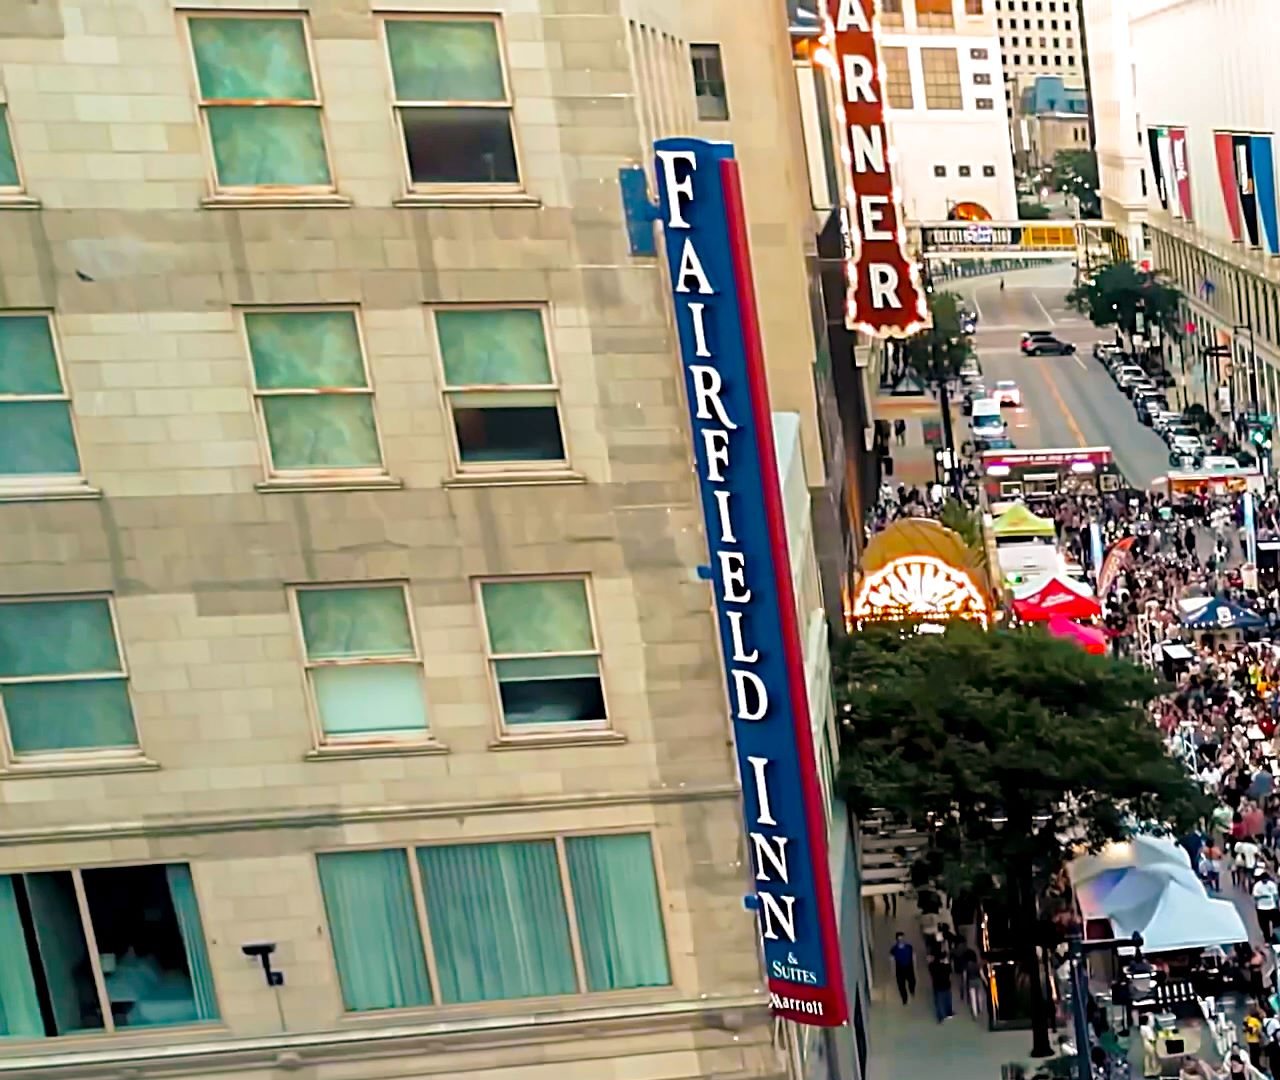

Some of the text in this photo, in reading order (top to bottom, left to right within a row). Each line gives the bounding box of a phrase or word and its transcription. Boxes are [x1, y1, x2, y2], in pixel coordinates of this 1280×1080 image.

[656, 150, 769, 720] FAIRFIELD
[747, 756, 797, 943] INN
[787, 951, 798, 964] &
[772, 960, 817, 984] SUITES
[768, 992, 824, 1016] Marriott
